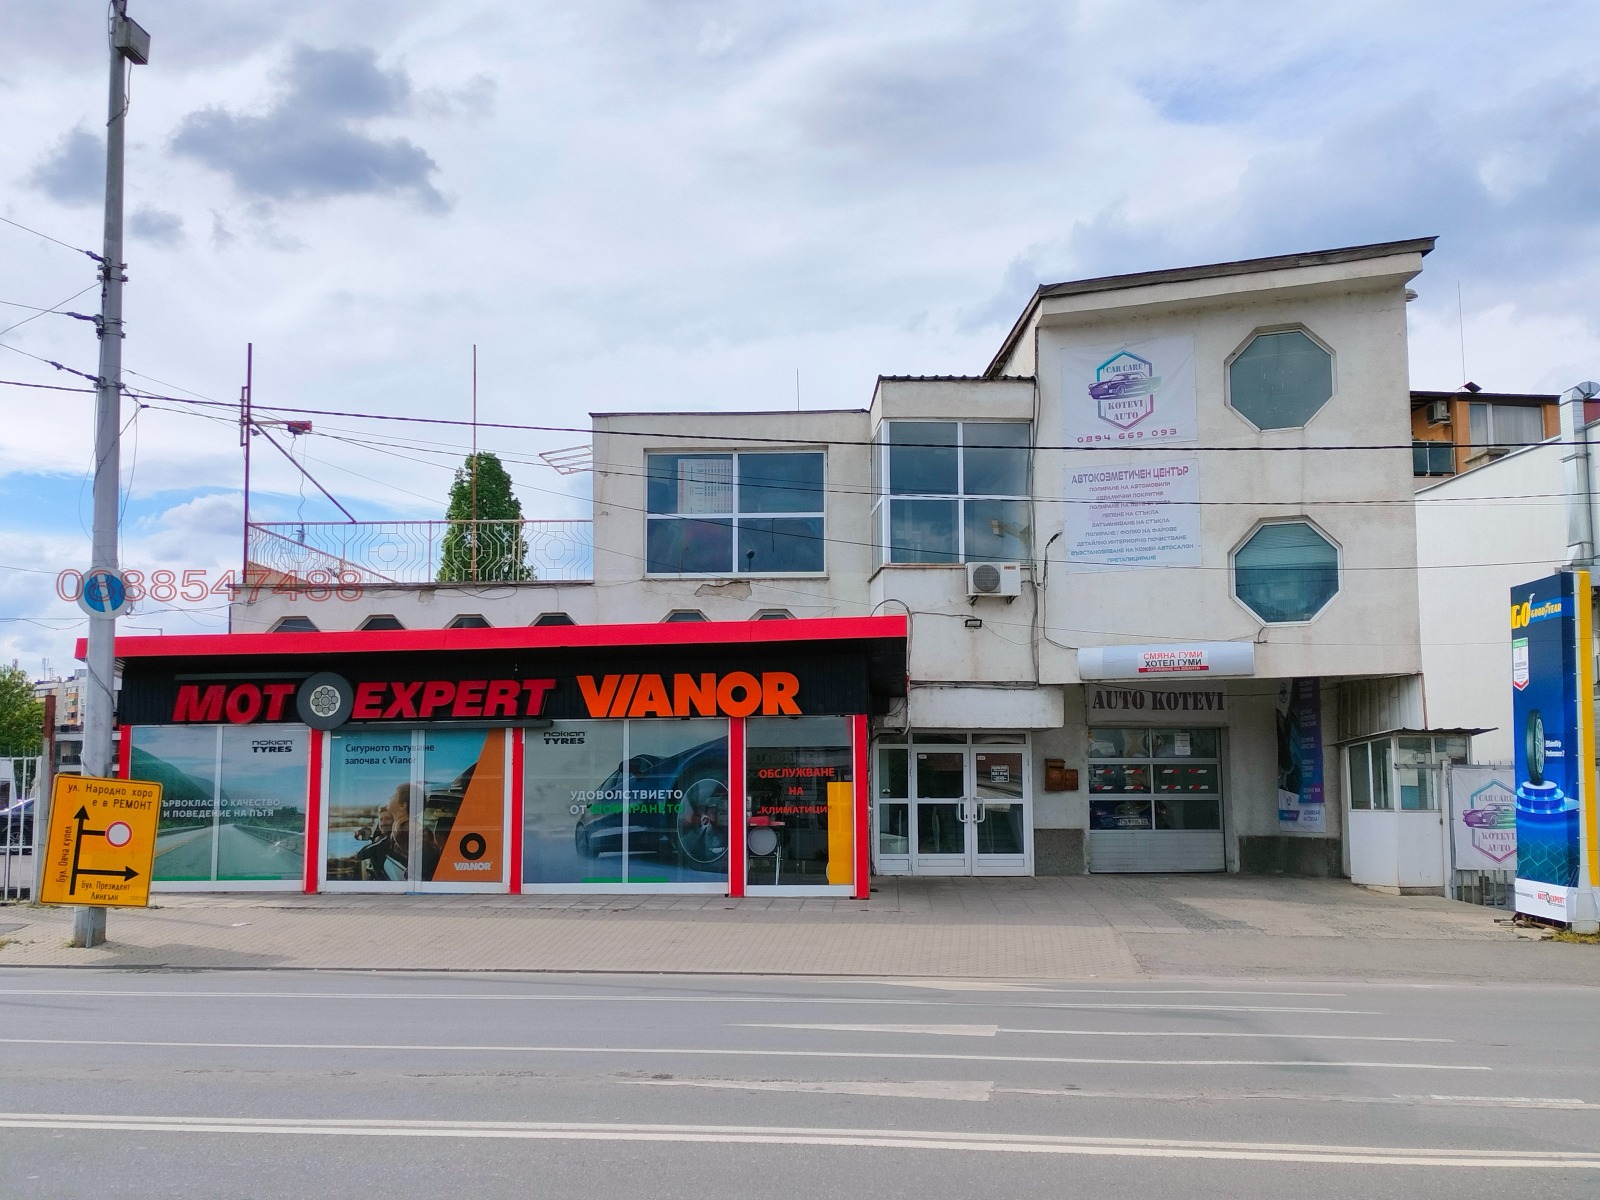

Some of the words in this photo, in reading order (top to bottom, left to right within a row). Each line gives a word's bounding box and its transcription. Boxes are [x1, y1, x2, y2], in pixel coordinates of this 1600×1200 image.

[1106, 366, 1121, 374] CAR
[1123, 363, 1143, 372] CARE
[1108, 400, 1143, 410] KOTEVI
[1113, 411, 1139, 421] AUTO
[1077, 434, 1111, 444] 0894
[1118, 431, 1144, 440] 669
[1151, 428, 1177, 437] 093
[1071, 469, 1151, 484] АВТОКОЗМЕТИЧЕН
[1153, 465, 1189, 480] ЦЕНТЪР
[1511, 602, 1530, 629] GO
[1143, 652, 1176, 660] СМЯНА
[350, 678, 557, 719] EXPERT
[576, 671, 802, 718] VIANOR
[1092, 690, 1145, 710] AUTO
[1151, 691, 1224, 711] KOTEVI
[345, 744, 390, 754] Сигурното
[345, 757, 380, 765] започва
[758, 767, 835, 778] ОБСЛУЖВАНЕ
[68, 784, 80, 794] ул.
[85, 784, 127, 796] Народно
[131, 789, 153, 799] хоро
[570, 789, 683, 801] УДОВОЛСТВИЕТО
[788, 786, 804, 795] НА
[113, 799, 153, 810] РЕМОНТ
[160, 799, 228, 807] ЪРВОКЛАСНО
[230, 799, 280, 807] КАЧЕСТВО
[172, 809, 231, 818] ПОВЕДЕНИЕ
[234, 809, 247, 817] НА
[249, 809, 274, 817] ПЪТЯ
[570, 805, 587, 815] ОТ
[63, 826, 73, 847] купел
[1481, 832, 1515, 840] KOTEVI
[58, 848, 69, 866] Овча
[453, 862, 491, 871] VIANOR
[56, 869, 69, 882] бул.
[96, 881, 131, 891] Президент
[91, 892, 119, 901] Линкълн
